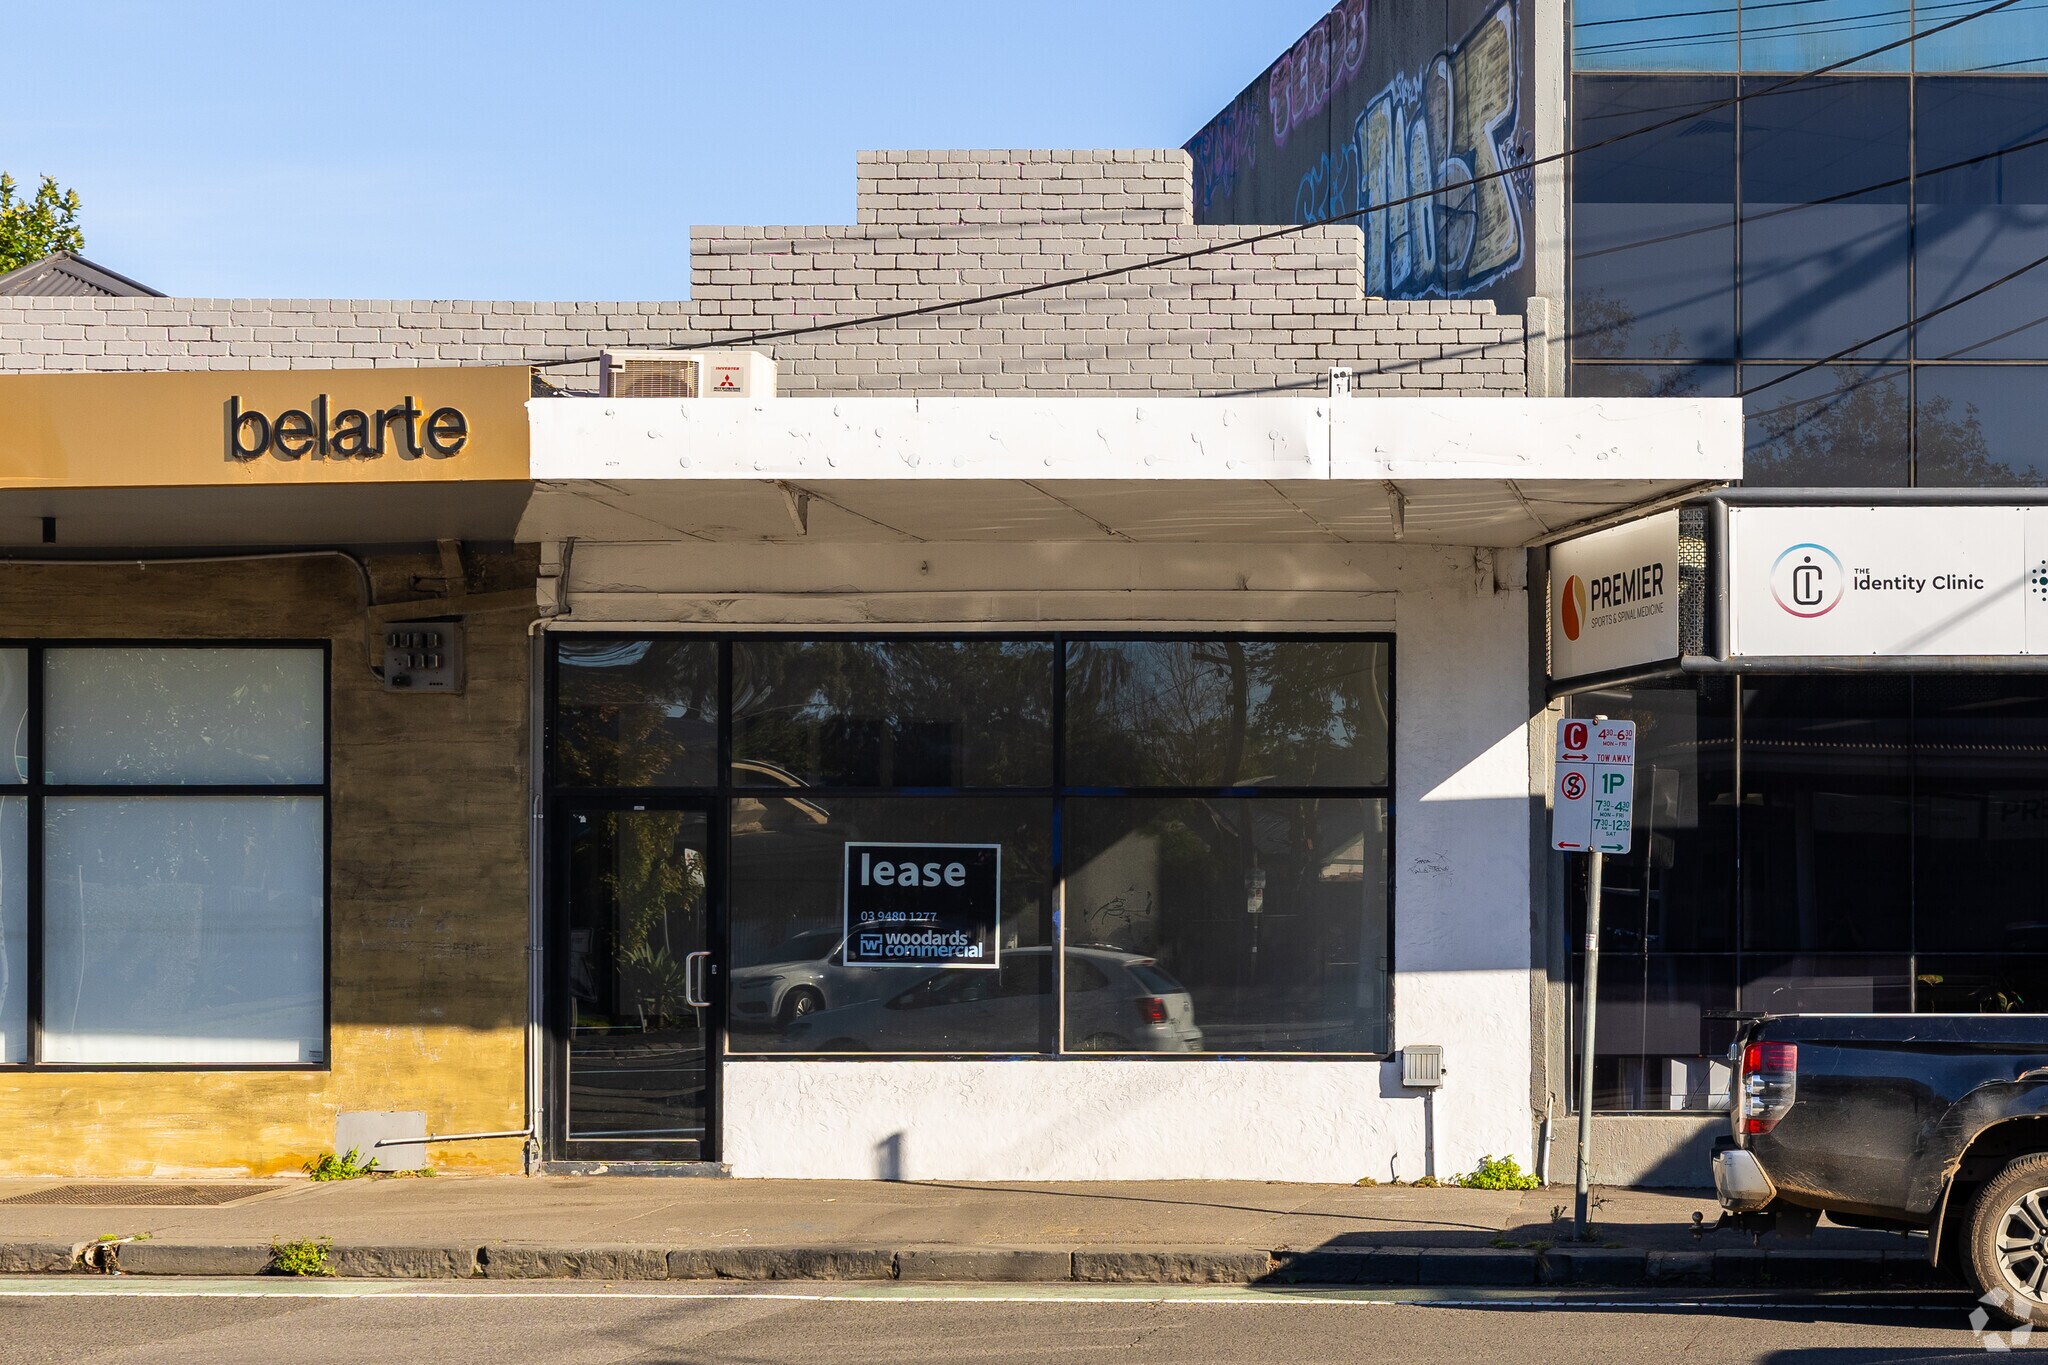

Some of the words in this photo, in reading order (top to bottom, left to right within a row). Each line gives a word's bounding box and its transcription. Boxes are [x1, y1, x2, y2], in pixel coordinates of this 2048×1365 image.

[231, 394, 469, 456] belarte
[1591, 562, 1664, 611] PREMIER
[1854, 574, 1926, 593] Identity
[1932, 574, 1984, 590] Clinic
[1591, 614, 1612, 628] SPORTS
[1612, 613, 1617, 624] &
[1617, 609, 1637, 622] SPINAL
[1637, 602, 1664, 618] MEDICINE
[1597, 754, 1611, 762] TOW
[1602, 773, 1625, 794] 1P
[861, 853, 966, 887] lease
[861, 911, 875, 921] 03
[877, 912, 906, 921] 9480
[909, 912, 937, 922] 1277
[885, 930, 968, 945] woodards
[885, 942, 983, 958] commercial
